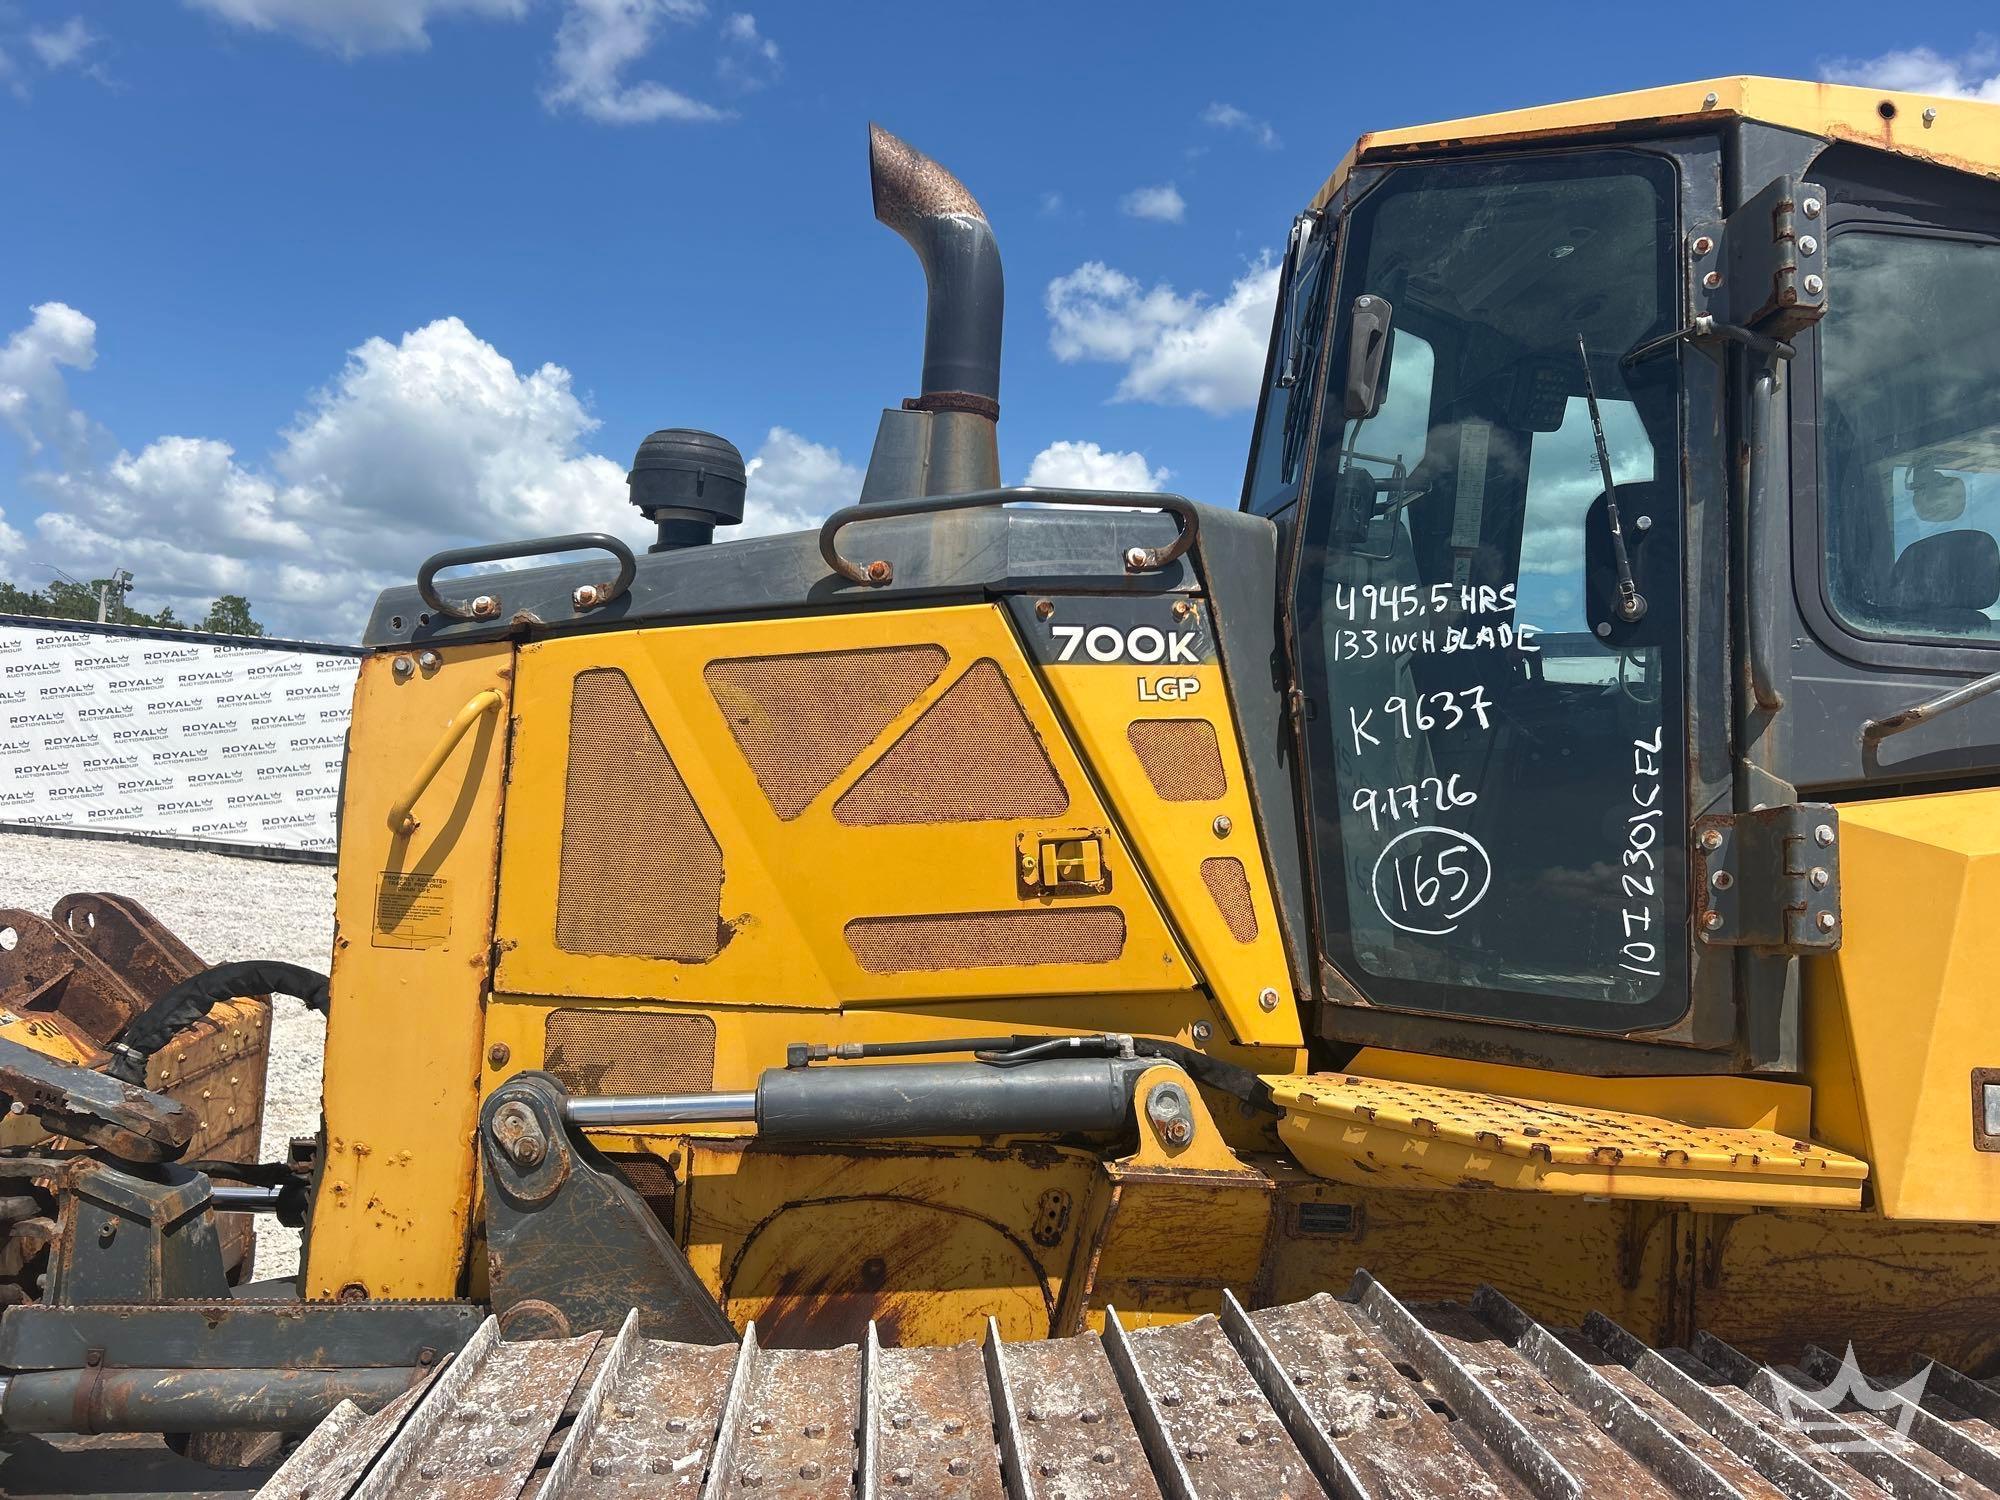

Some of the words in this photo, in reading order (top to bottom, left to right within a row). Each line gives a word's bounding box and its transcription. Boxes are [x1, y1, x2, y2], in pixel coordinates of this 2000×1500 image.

[1460, 583, 1516, 614] HRS
[36, 635, 78, 645] ROYAL
[1051, 626, 1199, 662] 700K
[1334, 629, 1378, 661] 133
[1385, 630, 1435, 653] INCH
[1440, 621, 1543, 654] BLADE
[144, 650, 186, 660] ROYAL
[75, 657, 118, 667] ROYAL
[316, 658, 358, 668] ROYAL
[6, 663, 48, 673] ROYAL
[248, 665, 290, 675] ROYAL
[179, 672, 222, 682] ROYAL
[109, 679, 152, 689] ROYAL
[1137, 677, 1200, 701] LGP
[40, 685, 82, 695] ROYAL
[286, 686, 328, 696] ROYAL
[217, 693, 260, 703] ROYAL
[148, 700, 190, 710] ROYAL
[79, 707, 122, 717] ROYAL
[320, 709, 352, 718] ROYA
[10, 714, 52, 724] ROYAL
[252, 715, 294, 725] ROYAL
[1350, 706, 1380, 755] K
[1384, 685, 1492, 738] 9637
[183, 722, 226, 732] ROYAL
[114, 729, 156, 739] ROYAL
[44, 736, 86, 746] ROYAL
[291, 736, 333, 746] ROYAL
[222, 743, 264, 753] ROYAL
[153, 750, 196, 760] ROYAL
[83, 757, 126, 767] ROYAL
[15, 764, 58, 774] ROYAL
[257, 765, 299, 775] ROYAL
[189, 772, 232, 782] ROYAL
[118, 779, 160, 789] ROYAL
[49, 786, 92, 796] ROYAL
[296, 787, 338, 796] ROYAL
[228, 794, 270, 804] ROYAL
[158, 801, 200, 811] ROYAL
[88, 807, 130, 817] ROYAL
[18, 814, 61, 824] ROYAL
[262, 815, 304, 825] ROYAL
[192, 822, 235, 832] ROYAL
[301, 837, 335, 846] ROYA
[1395, 845, 1468, 912] 165
